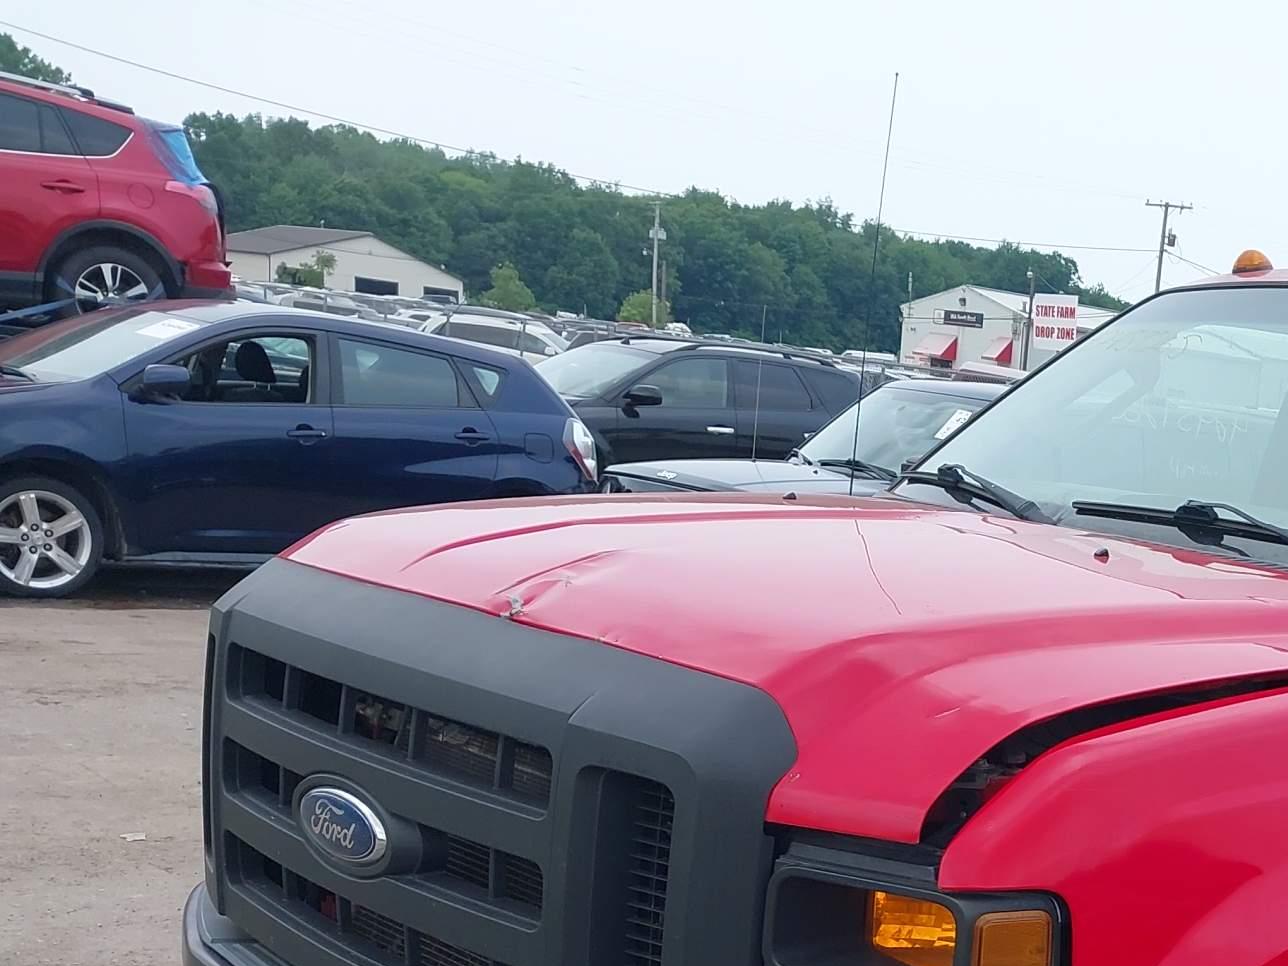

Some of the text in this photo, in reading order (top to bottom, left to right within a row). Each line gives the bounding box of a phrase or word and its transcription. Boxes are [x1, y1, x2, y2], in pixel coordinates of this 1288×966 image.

[1035, 305, 1076, 319] STATE FARM
[1035, 325, 1075, 340] DROP ZONE
[311, 799, 356, 848] Ford
